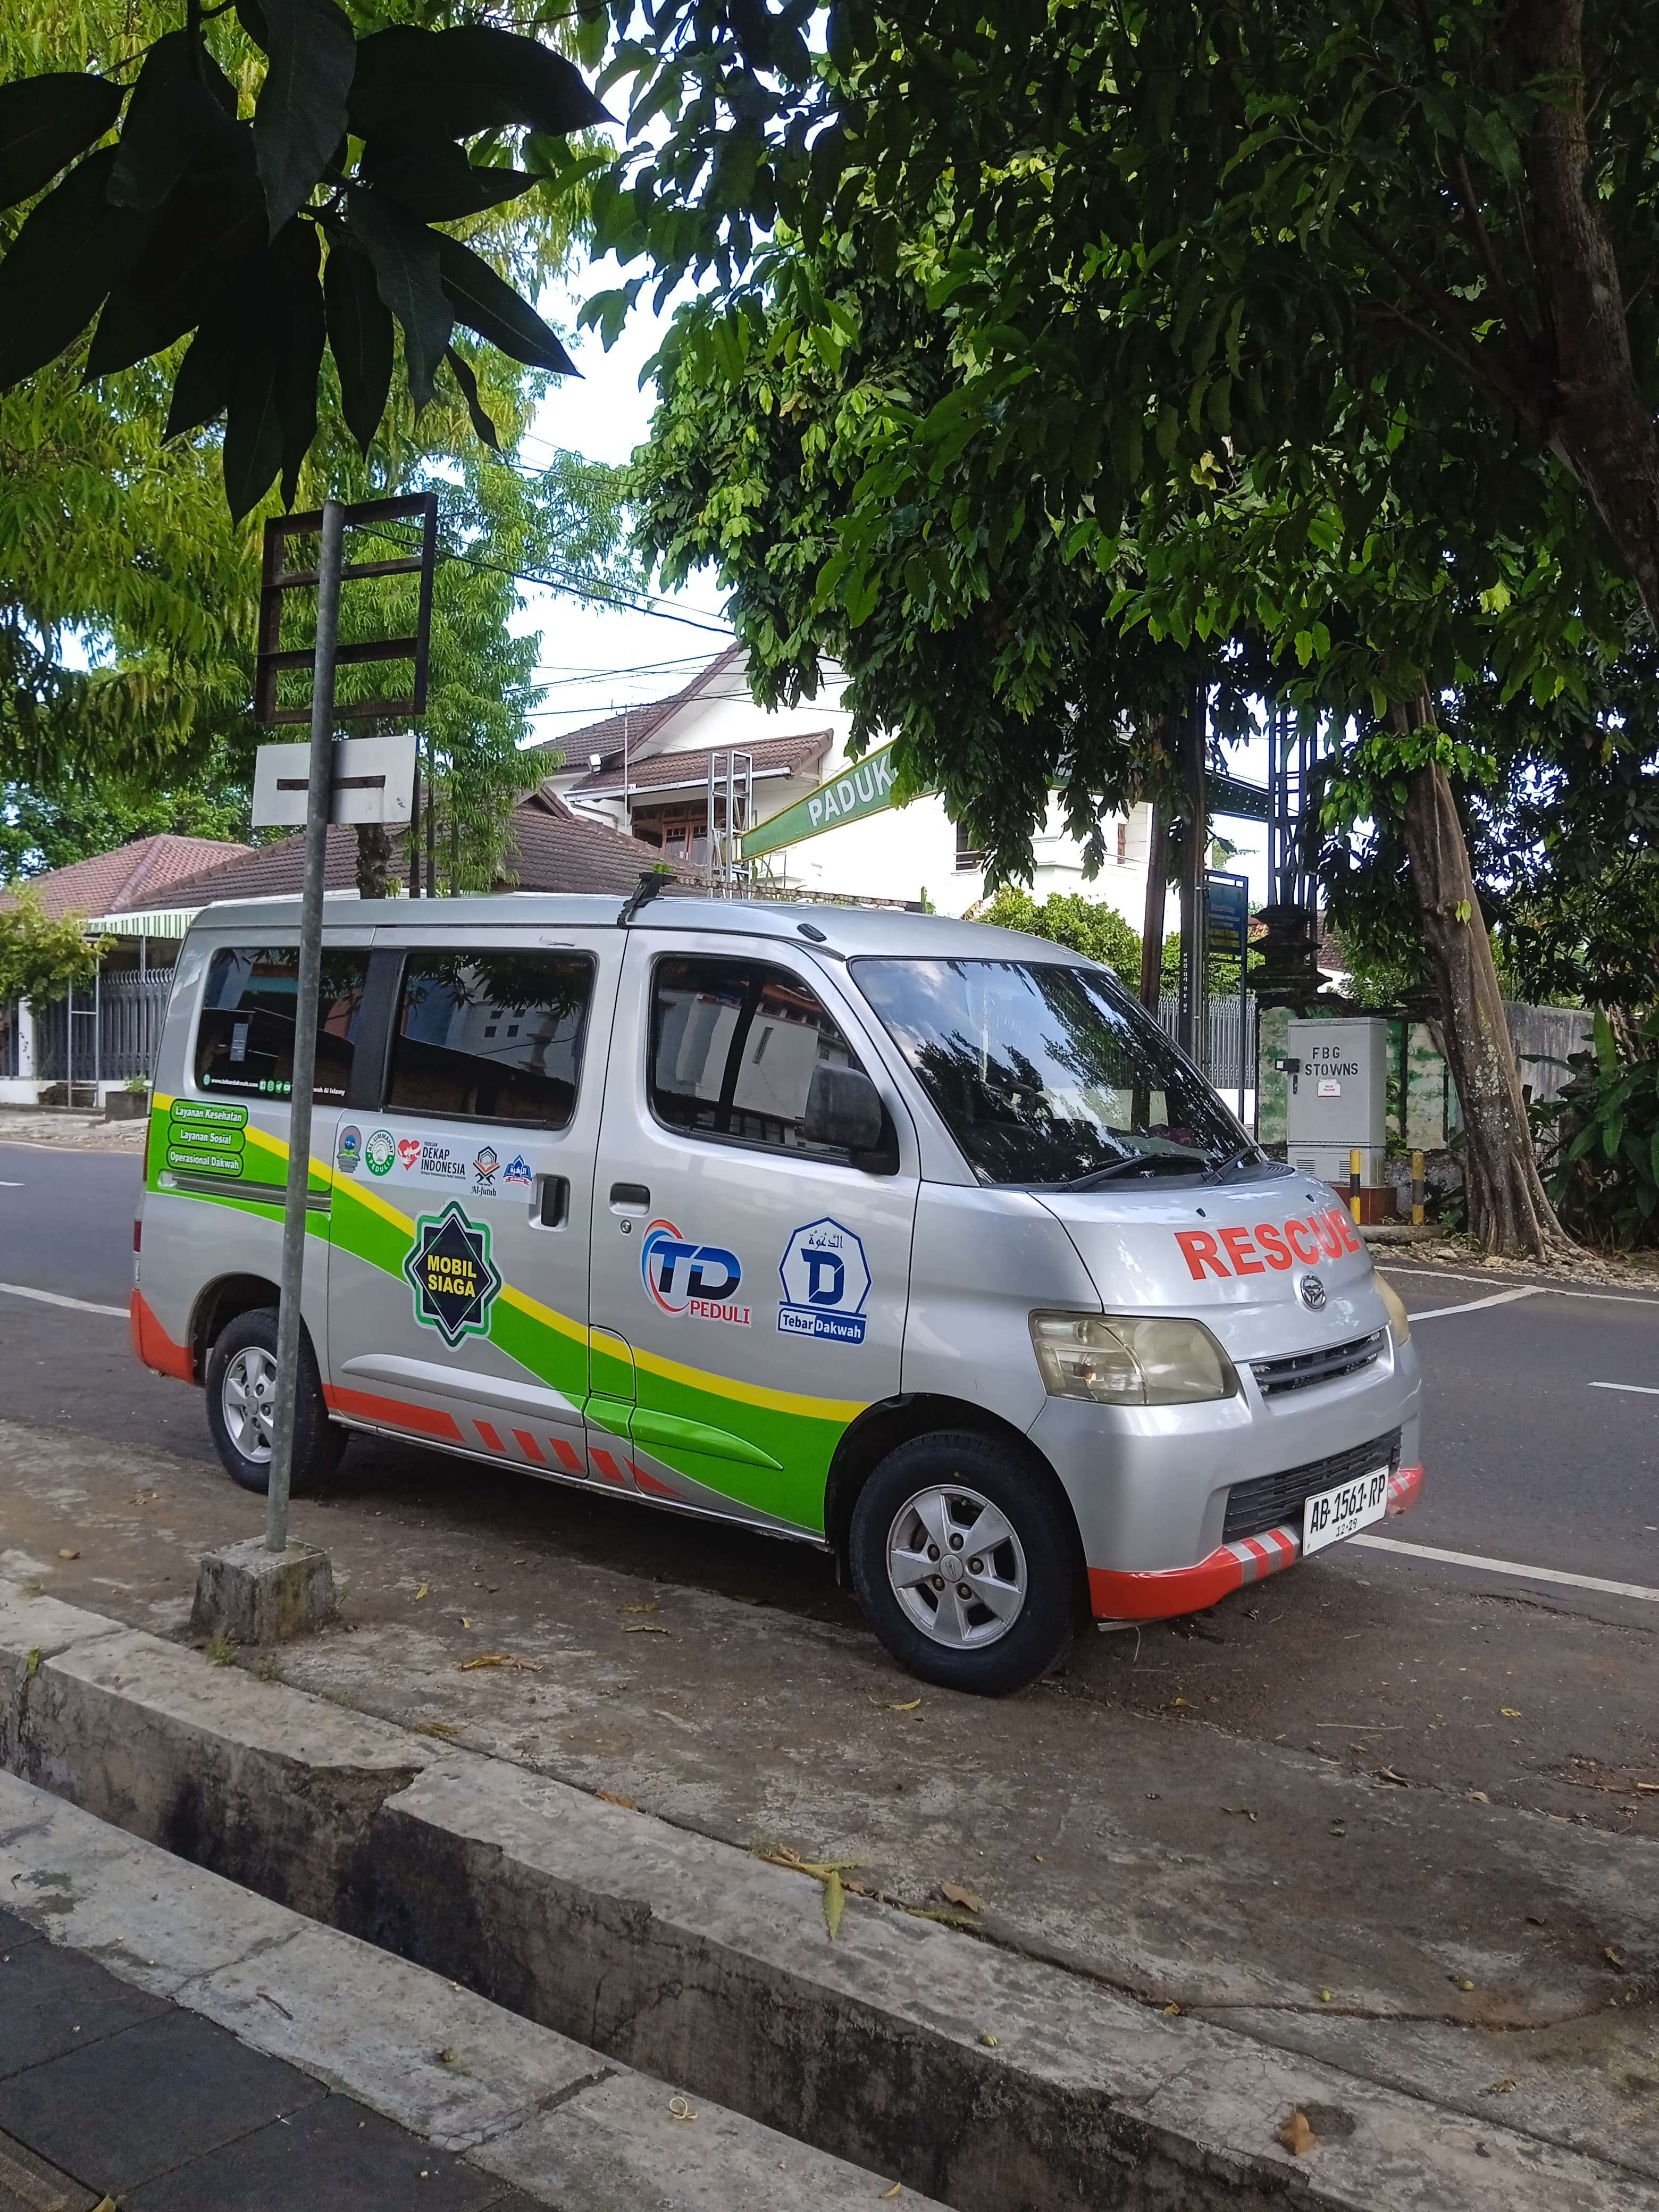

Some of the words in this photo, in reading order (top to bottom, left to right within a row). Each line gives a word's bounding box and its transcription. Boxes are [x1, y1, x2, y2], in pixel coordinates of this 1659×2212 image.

[808, 754, 899, 828] PADUK
[1305, 1062, 1359, 1076] STOWNS
[175, 1105, 204, 1118] Layanan
[205, 1108, 242, 1122] Kesehatan
[180, 1129, 208, 1142] Layanan
[210, 1132, 232, 1144] Sosial
[170, 1151, 210, 1166] Operasional
[211, 1157, 239, 1169] Dakwah
[422, 1146, 450, 1160] DEKAP
[368, 1159, 390, 1172] PEDULI
[421, 1158, 465, 1175] INDONESIA
[1174, 1208, 1360, 1280] RESCUE
[427, 1254, 477, 1278] MOBIL
[428, 1274, 476, 1297] SIAGA
[690, 1300, 750, 1325] PEDULI
[783, 1313, 814, 1330] Tebar
[815, 1321, 862, 1339] Dakwah
